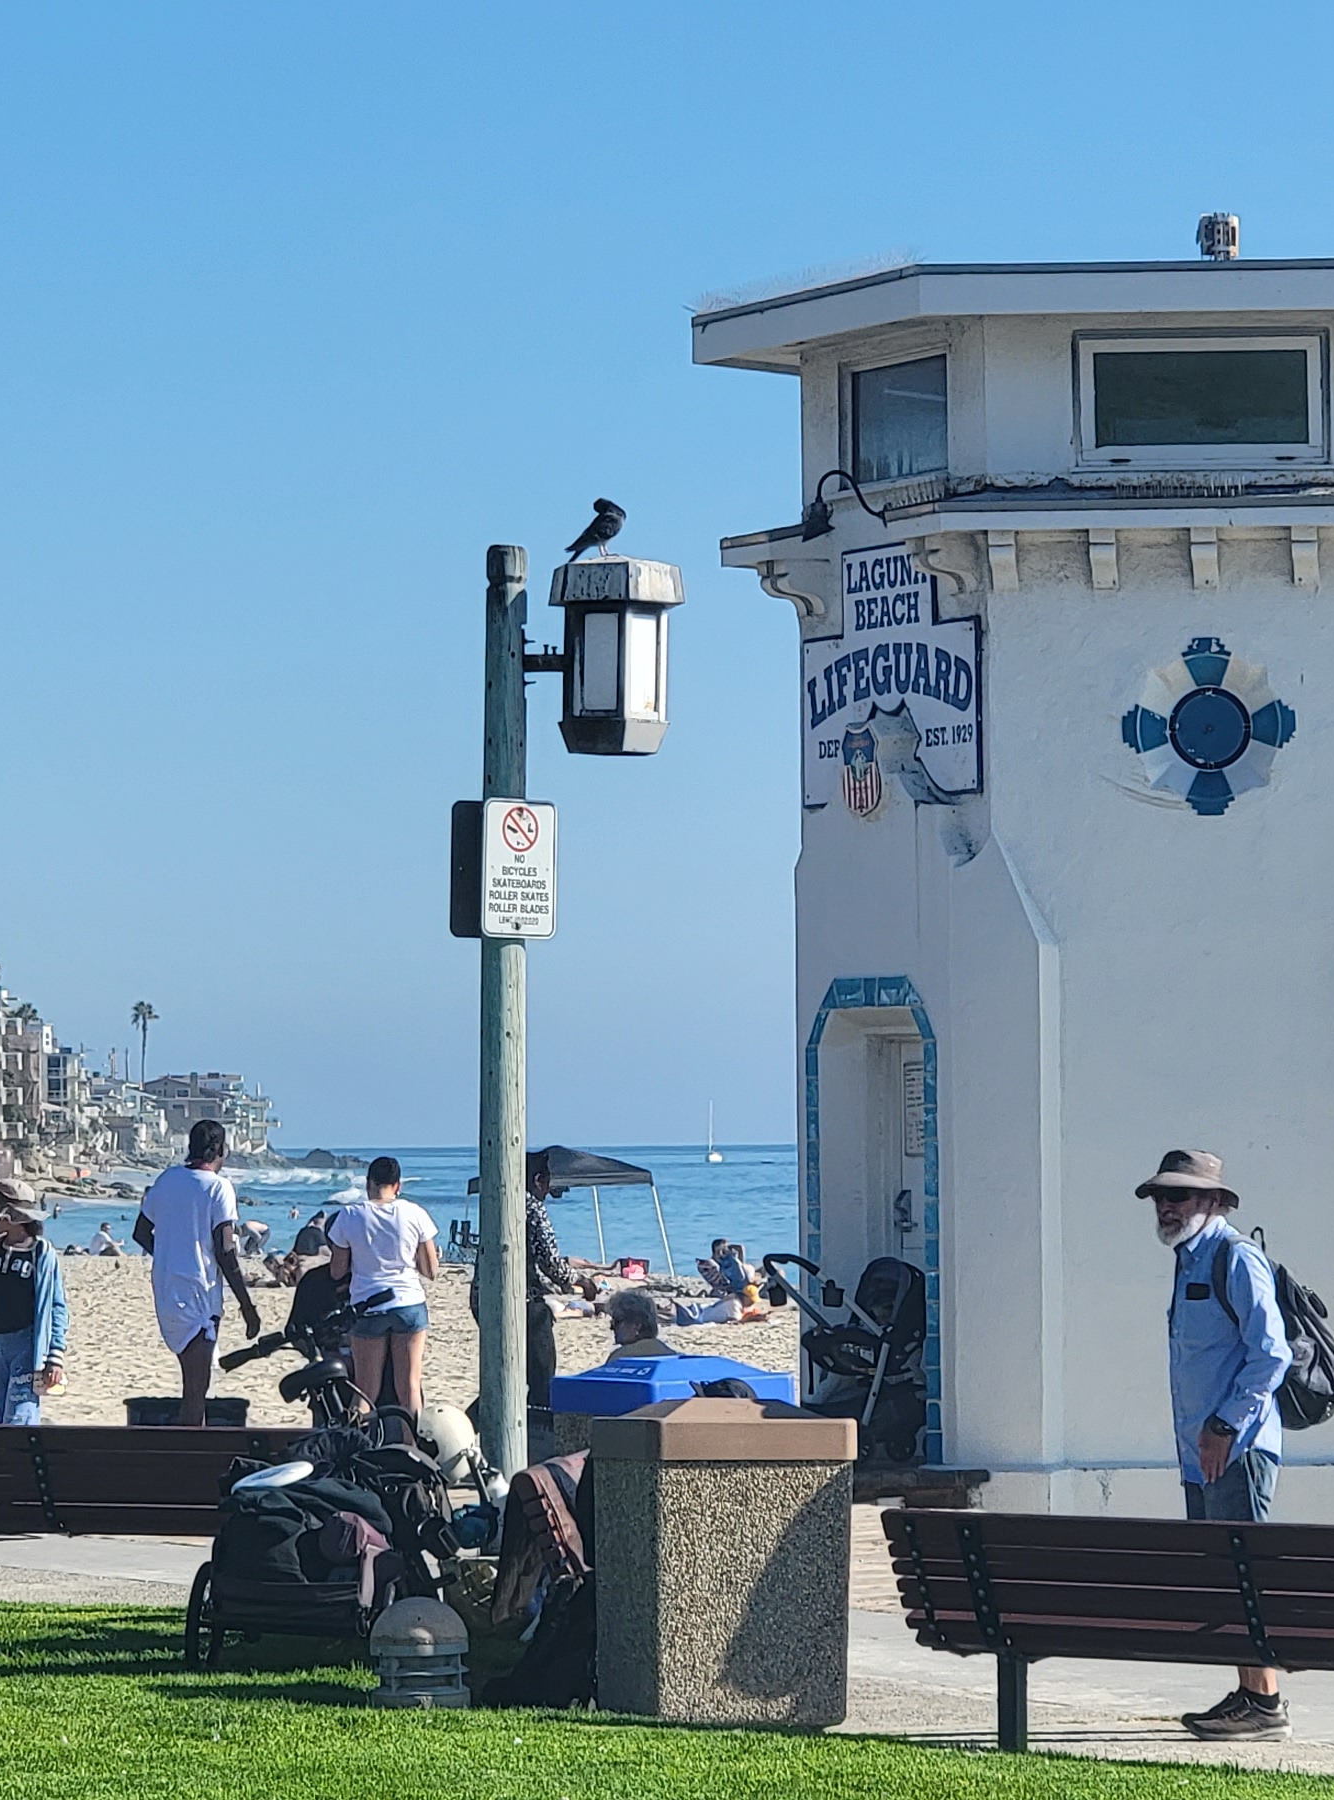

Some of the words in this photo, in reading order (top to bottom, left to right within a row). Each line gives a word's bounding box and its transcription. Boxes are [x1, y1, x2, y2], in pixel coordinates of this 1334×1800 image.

[854, 590, 921, 632] BEACH
[807, 642, 974, 730] LIFEGUARD
[925, 726, 949, 748] EST.
[951, 723, 974, 746] 1929
[818, 738, 841, 760] DEP
[514, 854, 526, 864] NO
[502, 866, 538, 877] BICYCLES
[492, 878, 547, 890] SKATEBOARDS
[489, 890, 518, 901] ROLLER
[520, 891, 549, 902] SKATES
[489, 902, 518, 913] ROLLER
[520, 903, 550, 914] BLADES
